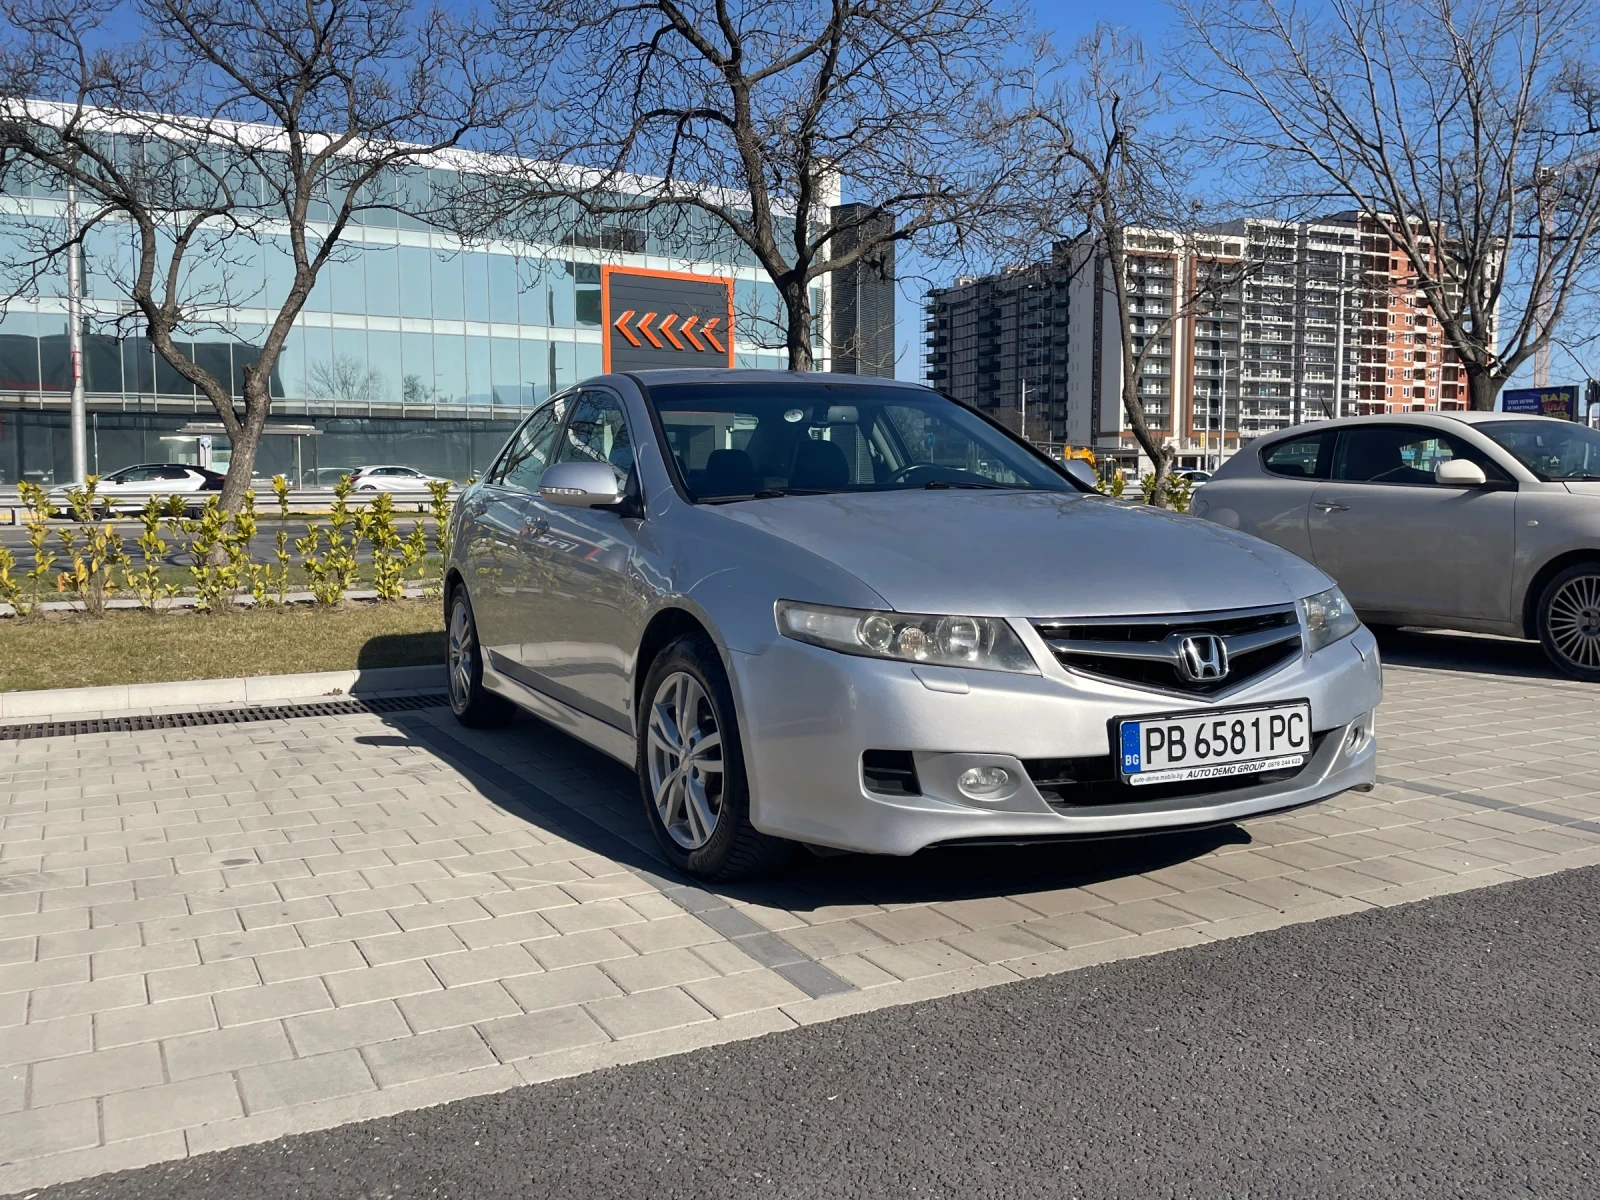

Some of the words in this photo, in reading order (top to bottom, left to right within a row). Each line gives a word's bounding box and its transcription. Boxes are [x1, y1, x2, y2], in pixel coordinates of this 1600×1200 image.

[1541, 392, 1569, 402] BAR
[1145, 725, 1187, 764] PB
[1194, 717, 1261, 759] 6581
[1269, 712, 1304, 751] PC
[1125, 754, 1139, 766] BG
[1186, 768, 1211, 779] AUTO
[1211, 765, 1236, 776] DEMO
[1237, 762, 1266, 773] GROUP
